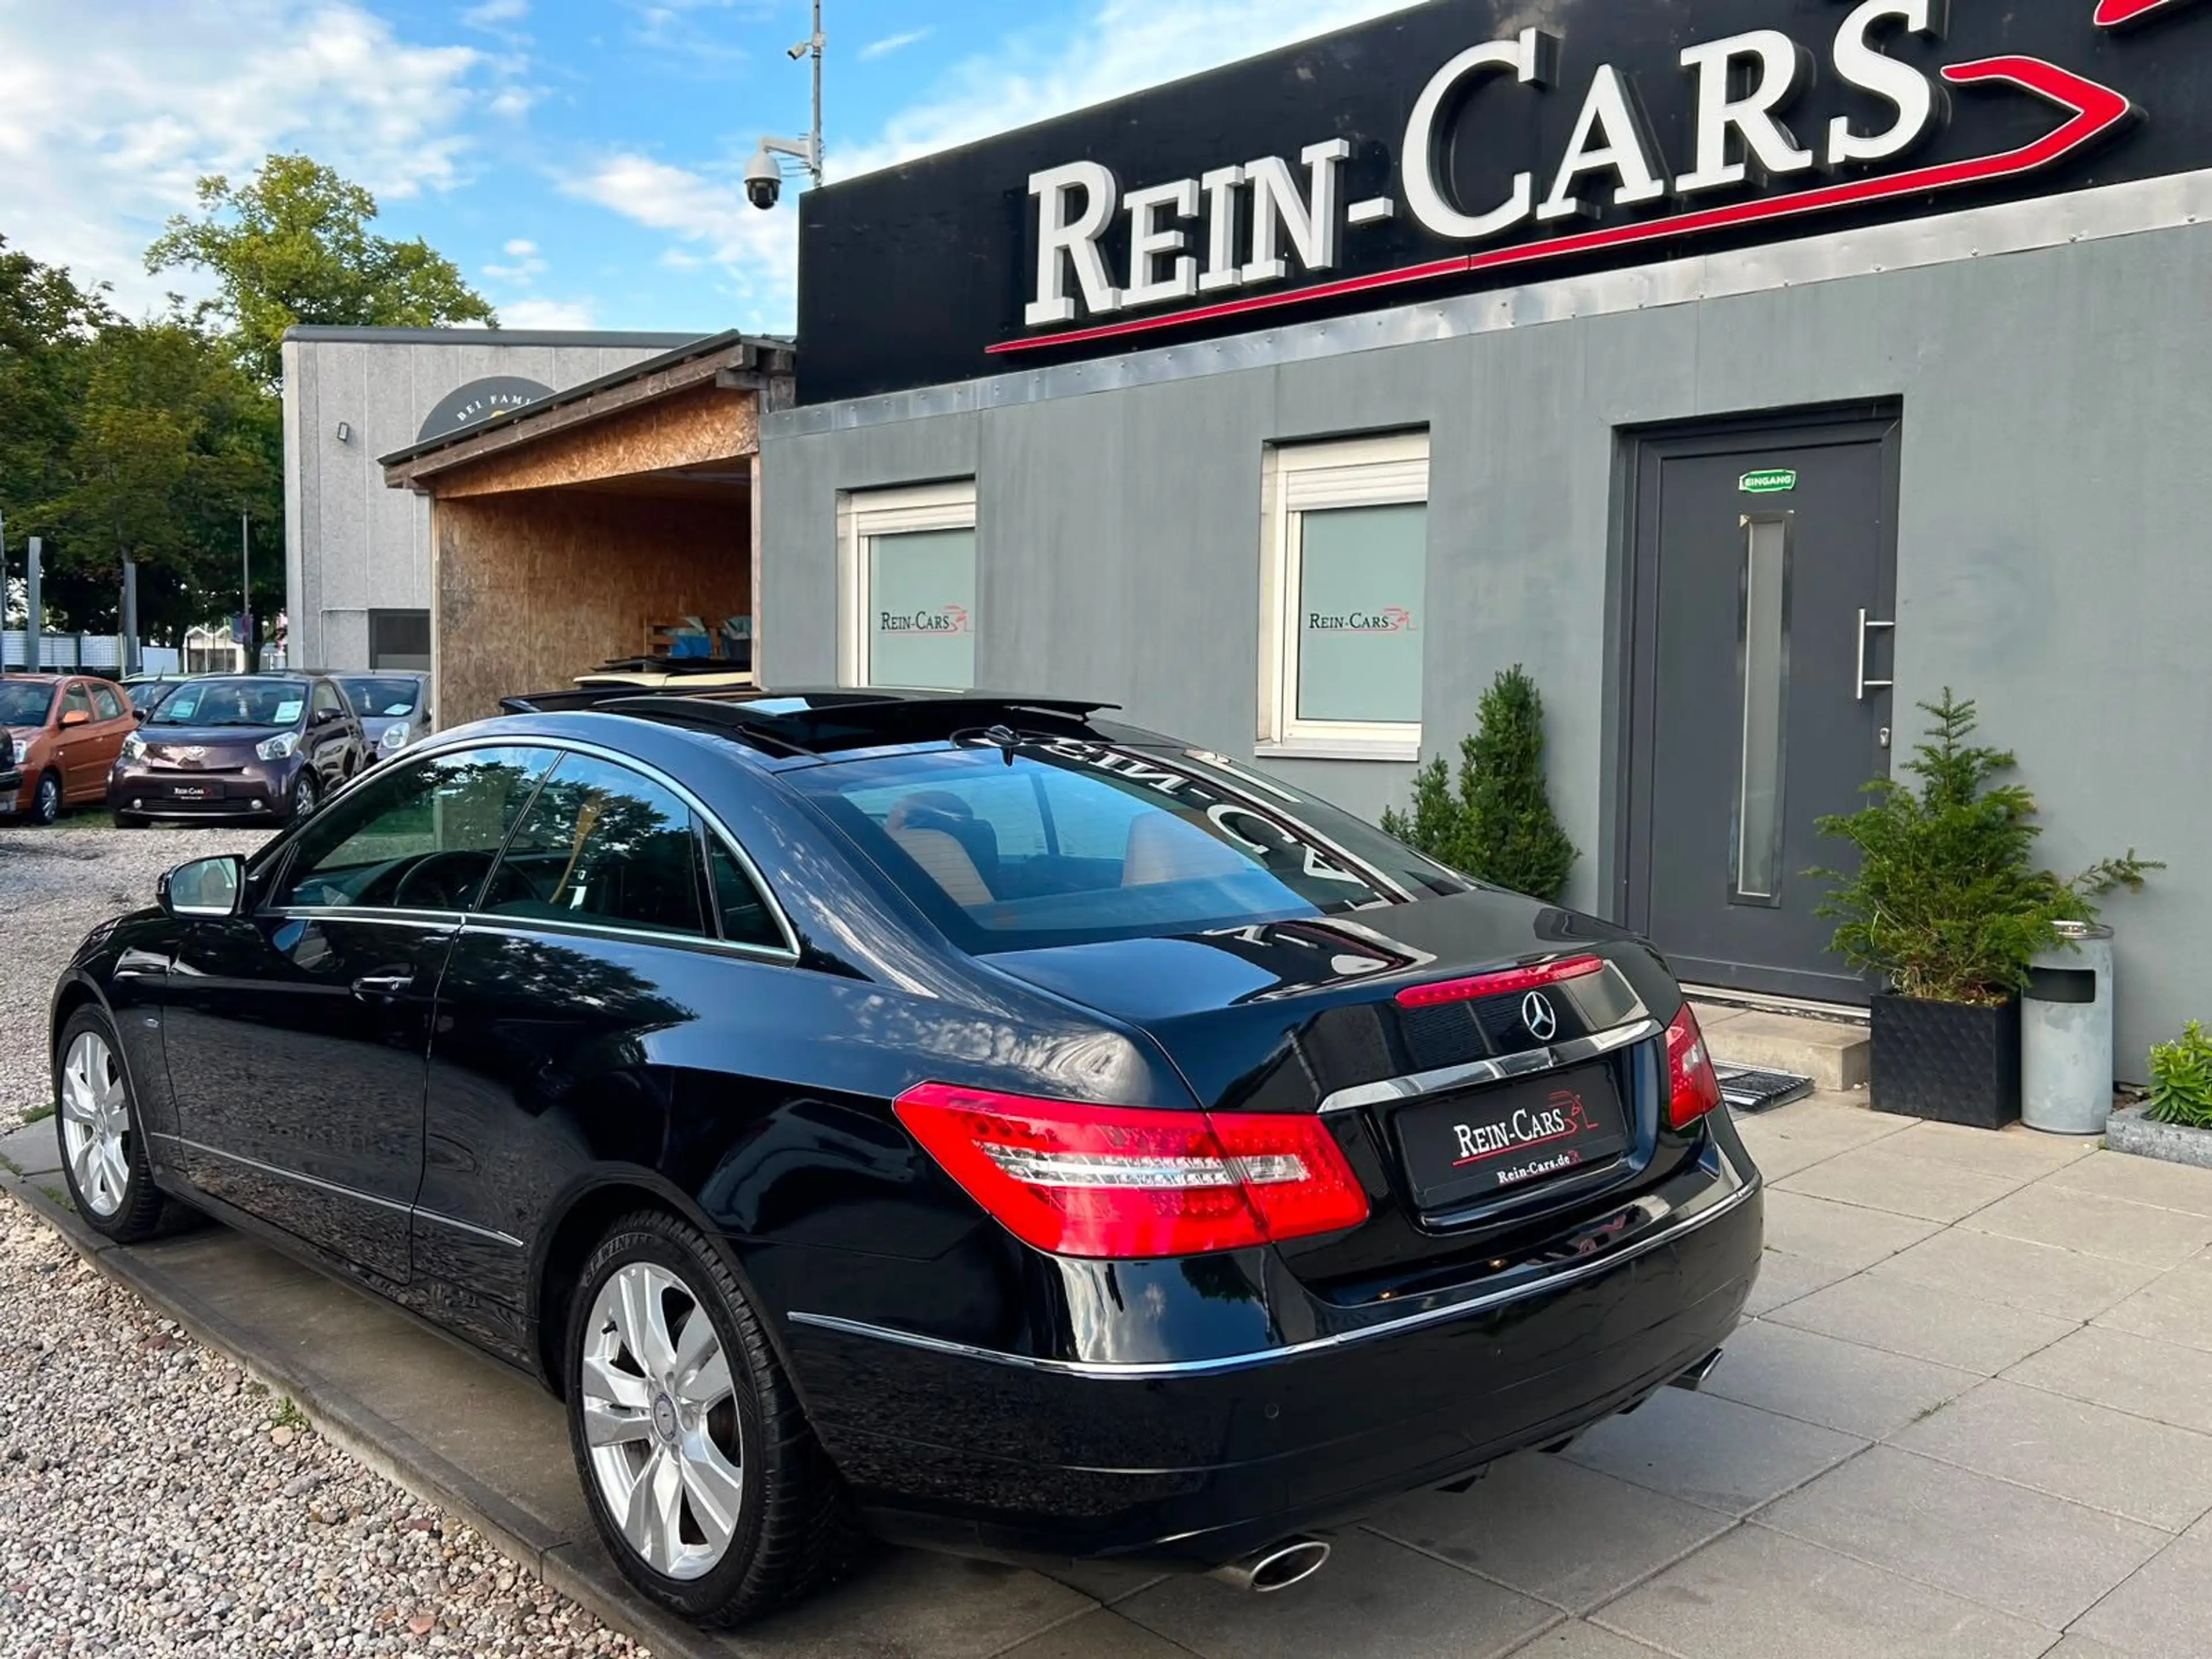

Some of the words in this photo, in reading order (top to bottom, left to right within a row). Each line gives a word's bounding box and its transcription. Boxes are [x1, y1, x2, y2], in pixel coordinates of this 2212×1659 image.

[457, 400, 482, 421] BEI
[1745, 475, 1791, 486] EINGANG
[1497, 1154, 1570, 1184] Rein-Cars.de
